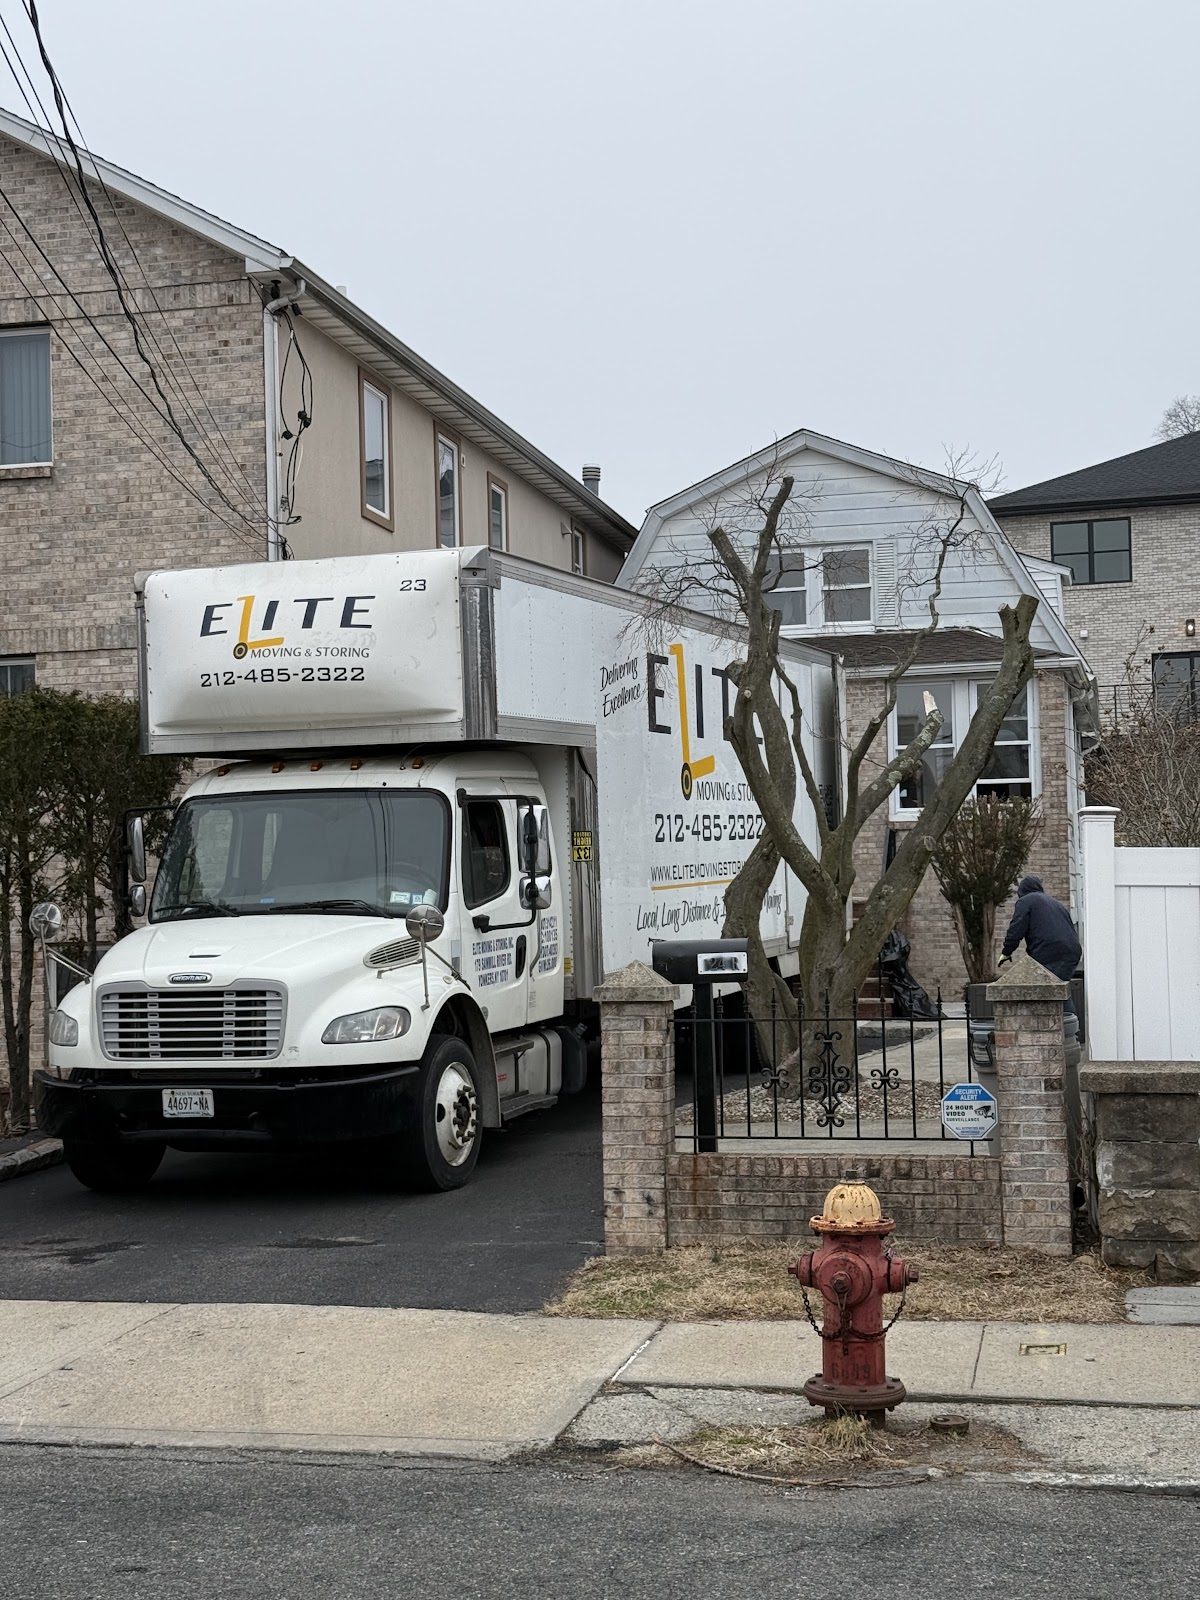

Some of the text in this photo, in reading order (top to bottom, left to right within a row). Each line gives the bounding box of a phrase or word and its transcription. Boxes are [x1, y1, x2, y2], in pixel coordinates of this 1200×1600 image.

[399, 579, 428, 592] 23
[200, 595, 376, 652] ELITE
[250, 646, 370, 659] MOVING & STORING
[200, 667, 365, 688] 212-485-2322
[600, 656, 639, 692] Delivering
[602, 683, 641, 718] Excellence
[646, 643, 764, 781] ELIT
[696, 781, 755, 802] MOVING & STO
[654, 813, 763, 843] 212-485-2322
[637, 904, 660, 931] Local,
[661, 902, 681, 933] Long
[681, 900, 712, 926] Distance
[712, 896, 720, 924] &
